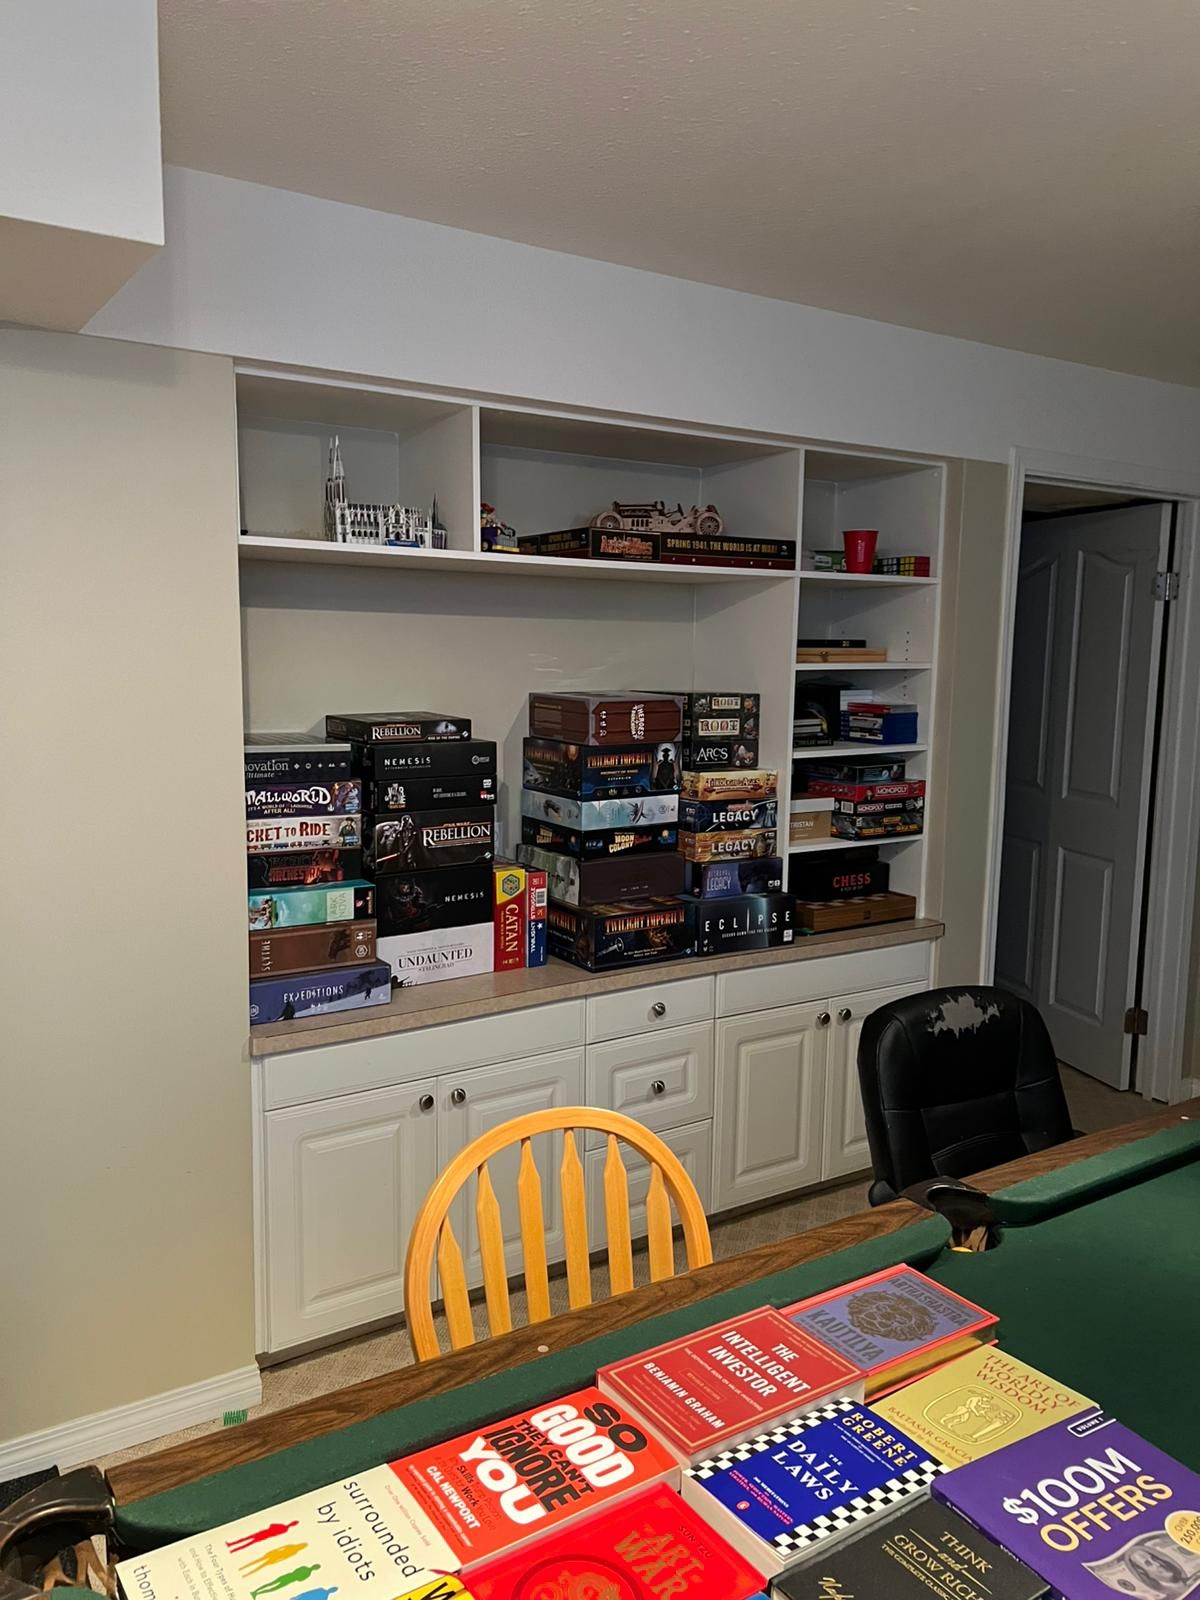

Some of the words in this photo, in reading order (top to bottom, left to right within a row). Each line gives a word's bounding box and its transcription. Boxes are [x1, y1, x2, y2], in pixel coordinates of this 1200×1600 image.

[667, 538, 691, 549] SPRING
[710, 541, 721, 551] THE
[722, 542, 744, 552] WORLD
[372, 727, 421, 740] REBELLION
[700, 719, 738, 732] ROOT
[384, 757, 431, 766] NEMESIS
[697, 748, 728, 761] ARCS
[247, 826, 282, 843] CKET
[284, 827, 297, 837] TO
[299, 822, 331, 836] RIDE
[423, 825, 491, 846] REBELLION
[713, 809, 759, 823] LEGACY
[609, 841, 634, 853] COLONY
[614, 834, 635, 843] MOON
[711, 839, 756, 853] LEGACY
[444, 891, 484, 902] NEMESIS
[832, 873, 871, 888] CHESS
[505, 904, 519, 952] CATAN
[605, 915, 645, 933] TWILIGHT
[646, 911, 685, 928] IMPERIUM
[261, 940, 271, 971] SCYTHE
[398, 948, 472, 969] UNDAUNTED
[283, 985, 344, 1003] EXPEDITIONS
[770, 1343, 799, 1362] THE
[806, 1309, 885, 1361] KAUTILYA
[707, 1345, 778, 1397] INVESTOR
[721, 1330, 812, 1393] INTELLIGENT
[985, 1354, 1018, 1373] THE
[1017, 1374, 1052, 1392] ART
[1055, 1392, 1081, 1408] OF
[643, 1362, 688, 1399] BENJAMIN
[684, 1394, 727, 1429] GRAHAM
[976, 1370, 1049, 1415] WISDOM
[982, 1362, 1065, 1411] WORLDLY
[530, 1404, 635, 1488] GOOD
[583, 1402, 648, 1452] SO
[842, 1417, 909, 1467] GREENE
[851, 1412, 918, 1461] ROBERT
[887, 1406, 934, 1440] BALTASAR
[934, 1435, 974, 1461] GRACIA
[1076, 1417, 1099, 1432] VOLUME
[457, 1465, 475, 1484] Skills
[483, 1425, 582, 1514] IGNORE
[513, 1418, 552, 1447] THEY
[548, 1449, 596, 1495] CAN'T
[772, 1451, 833, 1500] LAWS
[786, 1440, 859, 1494] DAILY
[828, 1454, 844, 1466] THE
[426, 1465, 444, 1484] CAL
[440, 1483, 481, 1529] NEWPORT
[459, 1436, 547, 1525] YOU
[461, 1487, 480, 1509] Work
[1002, 1447, 1142, 1525] $100M
[343, 1481, 425, 1577] surrounded
[1039, 1475, 1173, 1552] OFFERS
[317, 1501, 340, 1523] by
[333, 1527, 376, 1581] idiots
[648, 1530, 705, 1577] ART
[880, 1544, 895, 1558] THE
[894, 1553, 925, 1582] COMPLETE
[893, 1534, 944, 1579] GROW
[937, 1552, 969, 1572] and
[939, 1531, 993, 1575] THINK
[214, 1567, 229, 1586] Types
[614, 1530, 689, 1600] WAR
